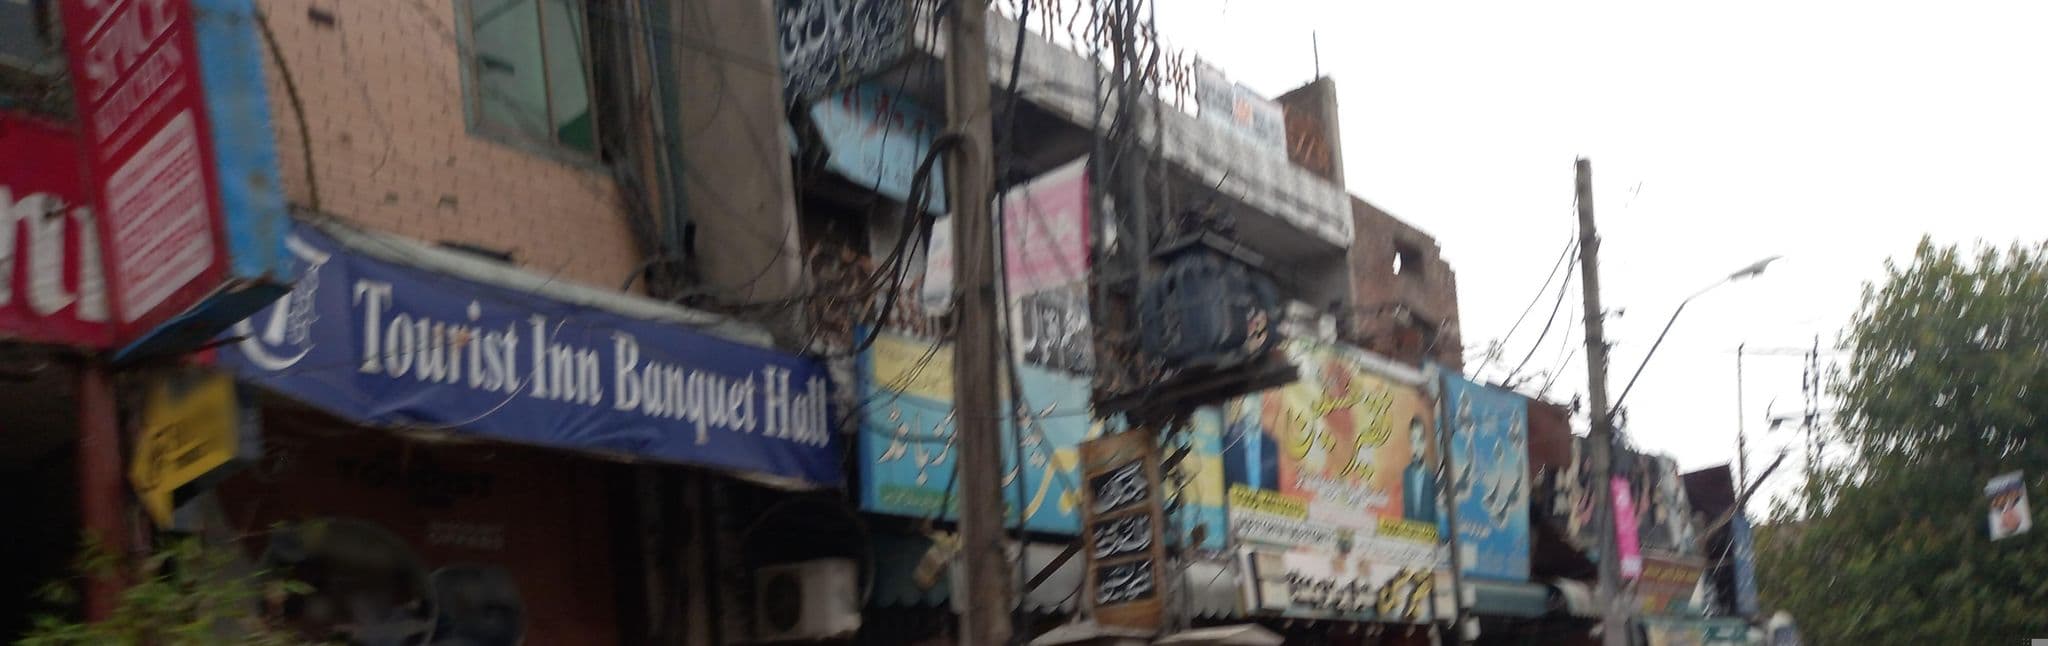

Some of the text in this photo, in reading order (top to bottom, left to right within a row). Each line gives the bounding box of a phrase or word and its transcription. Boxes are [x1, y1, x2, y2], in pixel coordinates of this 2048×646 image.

[352, 278, 521, 394] Tourist
[528, 312, 604, 407] Inn
[610, 330, 757, 446] Banquet
[761, 363, 831, 449] Hall
